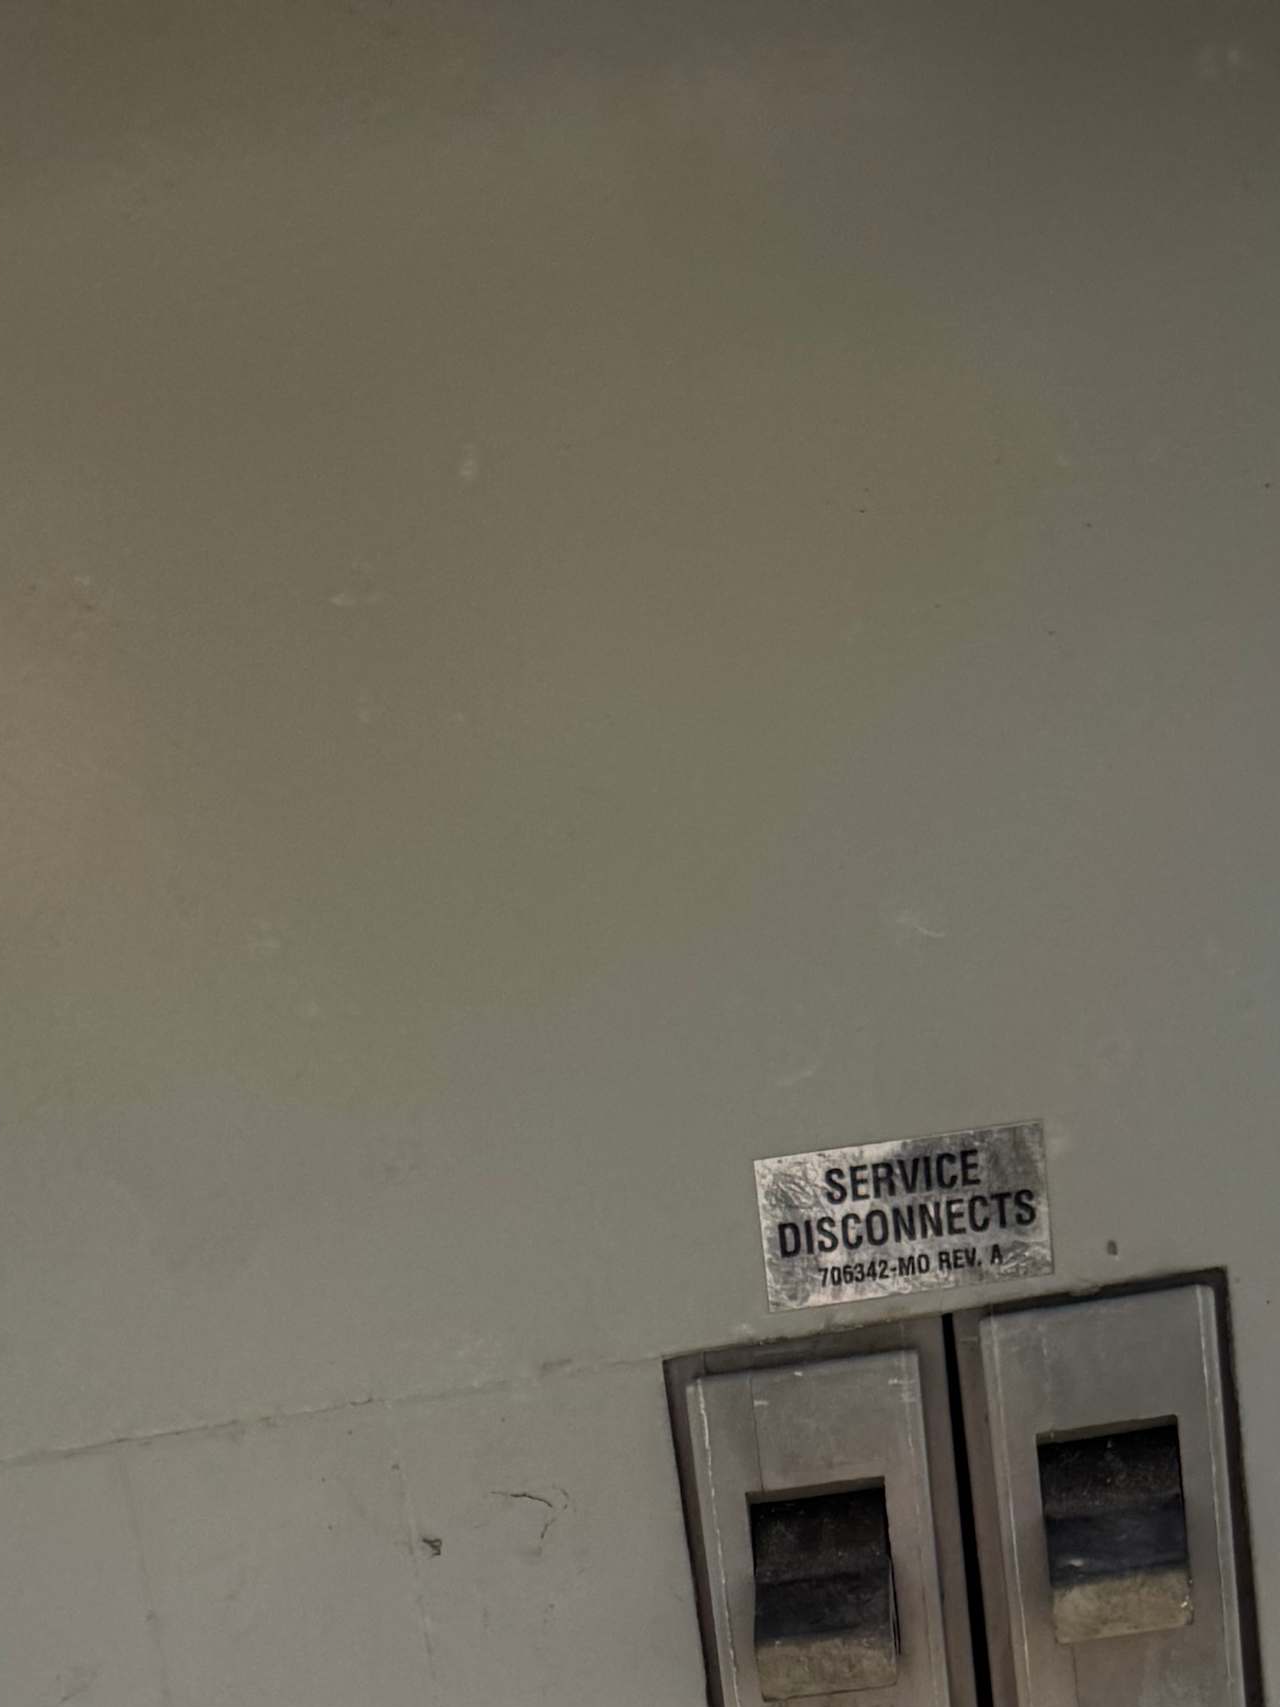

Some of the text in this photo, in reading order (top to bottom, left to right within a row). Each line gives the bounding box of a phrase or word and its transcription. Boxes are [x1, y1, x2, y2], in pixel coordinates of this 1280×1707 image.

[825, 1149, 981, 1204] SERVICE
[778, 1189, 1037, 1259] DISCONNECTS
[938, 1250, 983, 1272] REV.
[990, 1244, 1003, 1265] A
